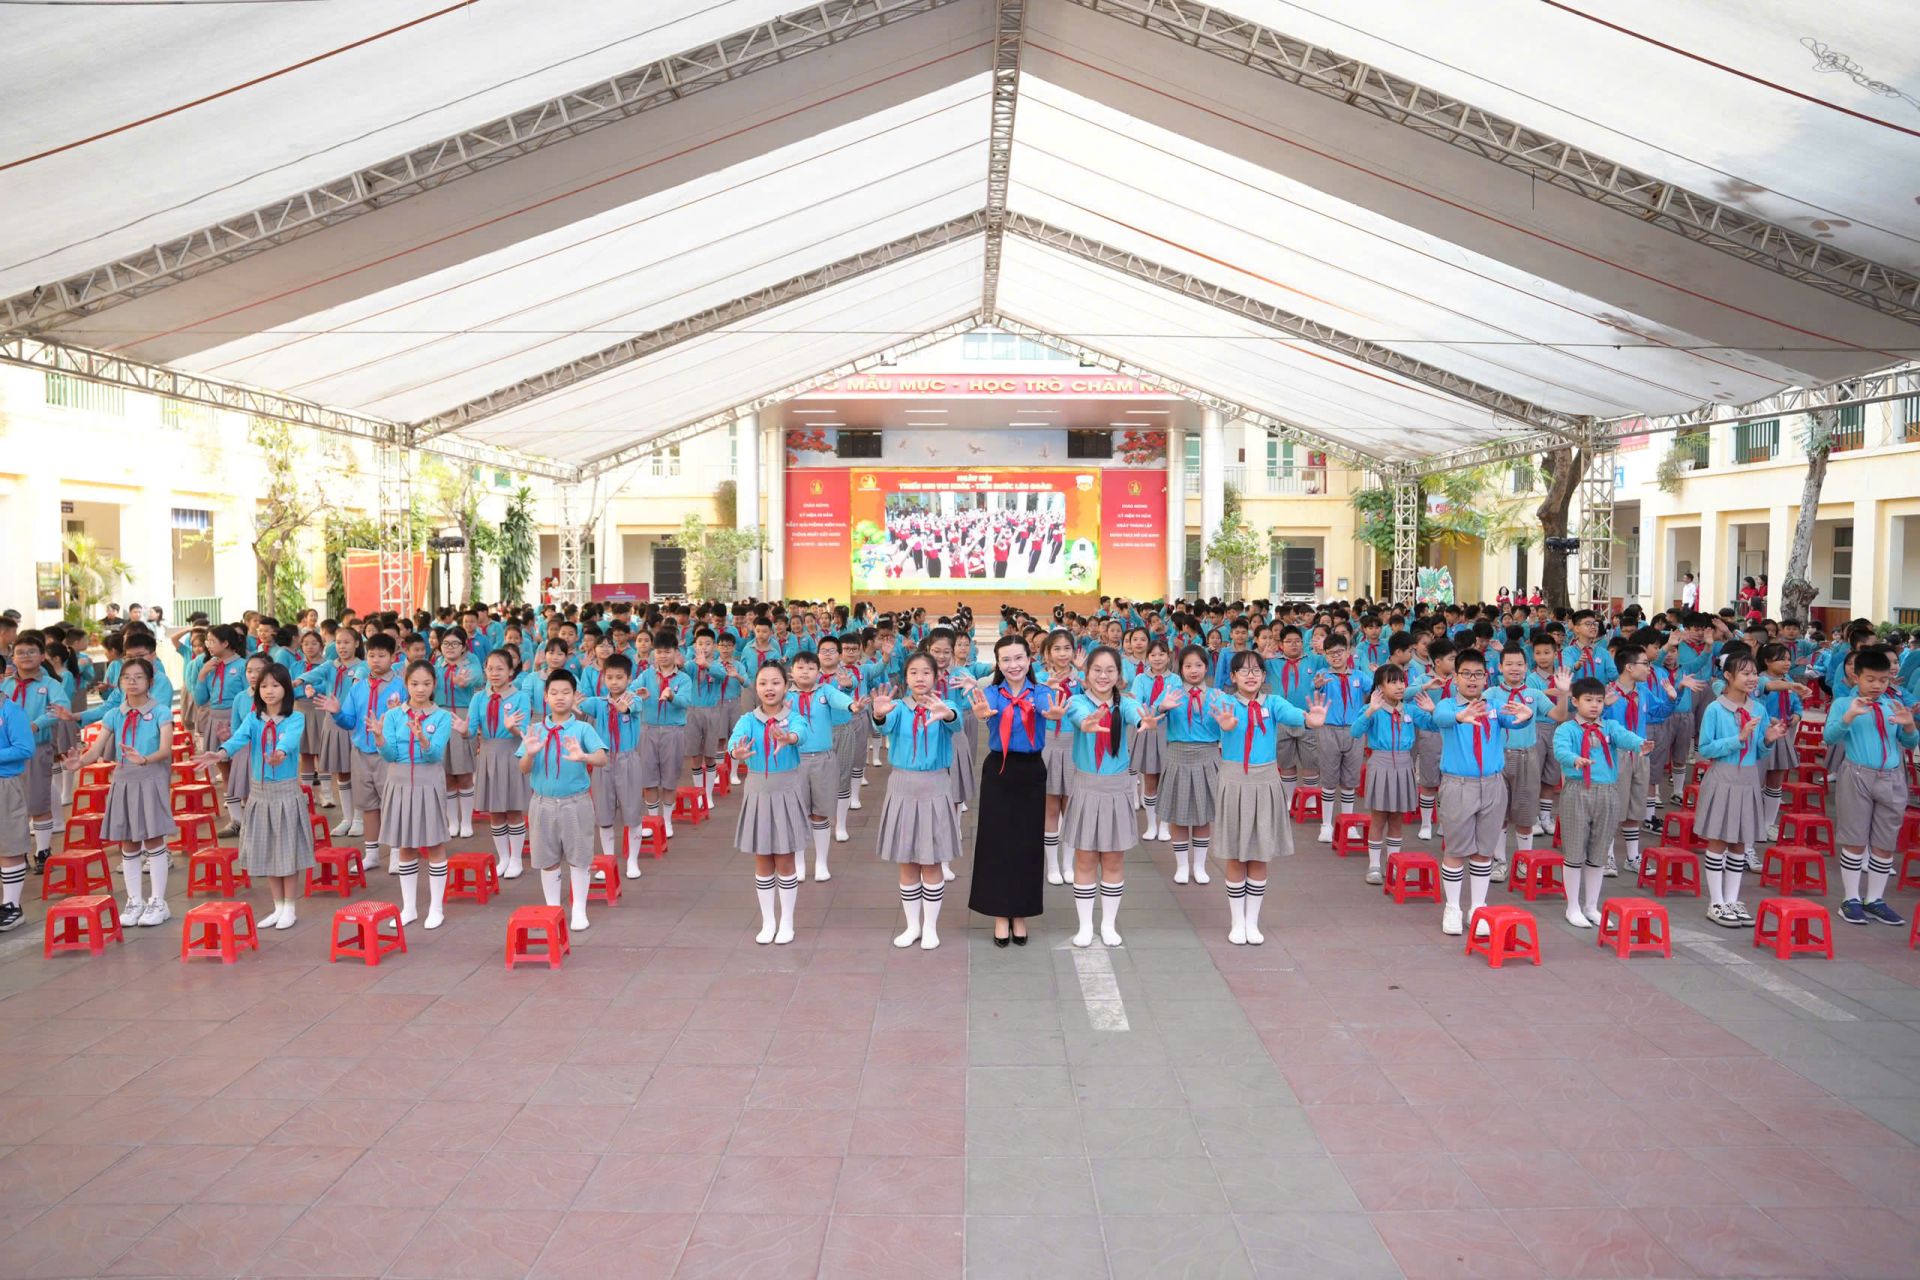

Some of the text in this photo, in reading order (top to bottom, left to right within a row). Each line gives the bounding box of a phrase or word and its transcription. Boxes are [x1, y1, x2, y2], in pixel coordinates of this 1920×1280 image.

[847, 374, 893, 392] MẪU
[899, 377, 946, 394] MỰC
[967, 379, 1017, 394] HỌC
[1025, 376, 1065, 393] TRÒ
[1071, 377, 1134, 393] CHĂM
